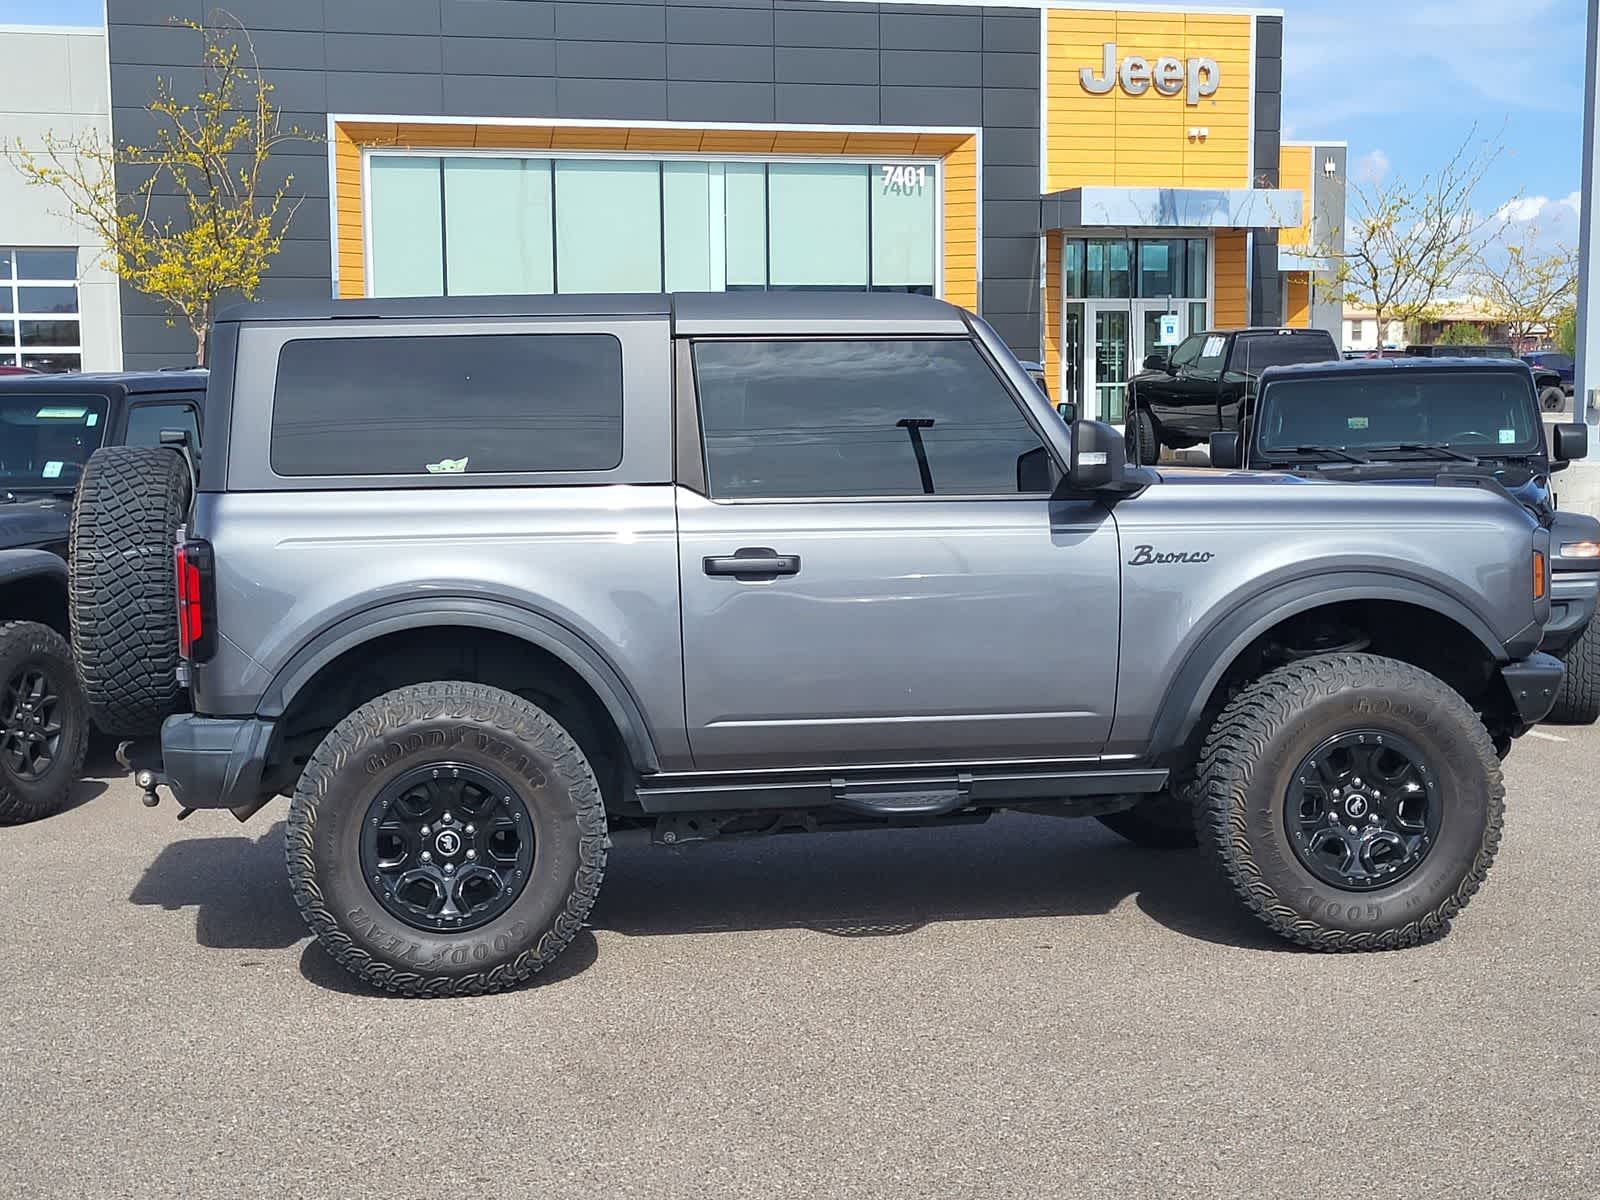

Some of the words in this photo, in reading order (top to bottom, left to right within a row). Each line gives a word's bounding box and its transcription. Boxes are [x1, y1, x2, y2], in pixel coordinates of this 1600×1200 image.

[1079, 42, 1220, 107] Jeep
[882, 165, 925, 187] 7401
[1128, 545, 1215, 566] Bronco
